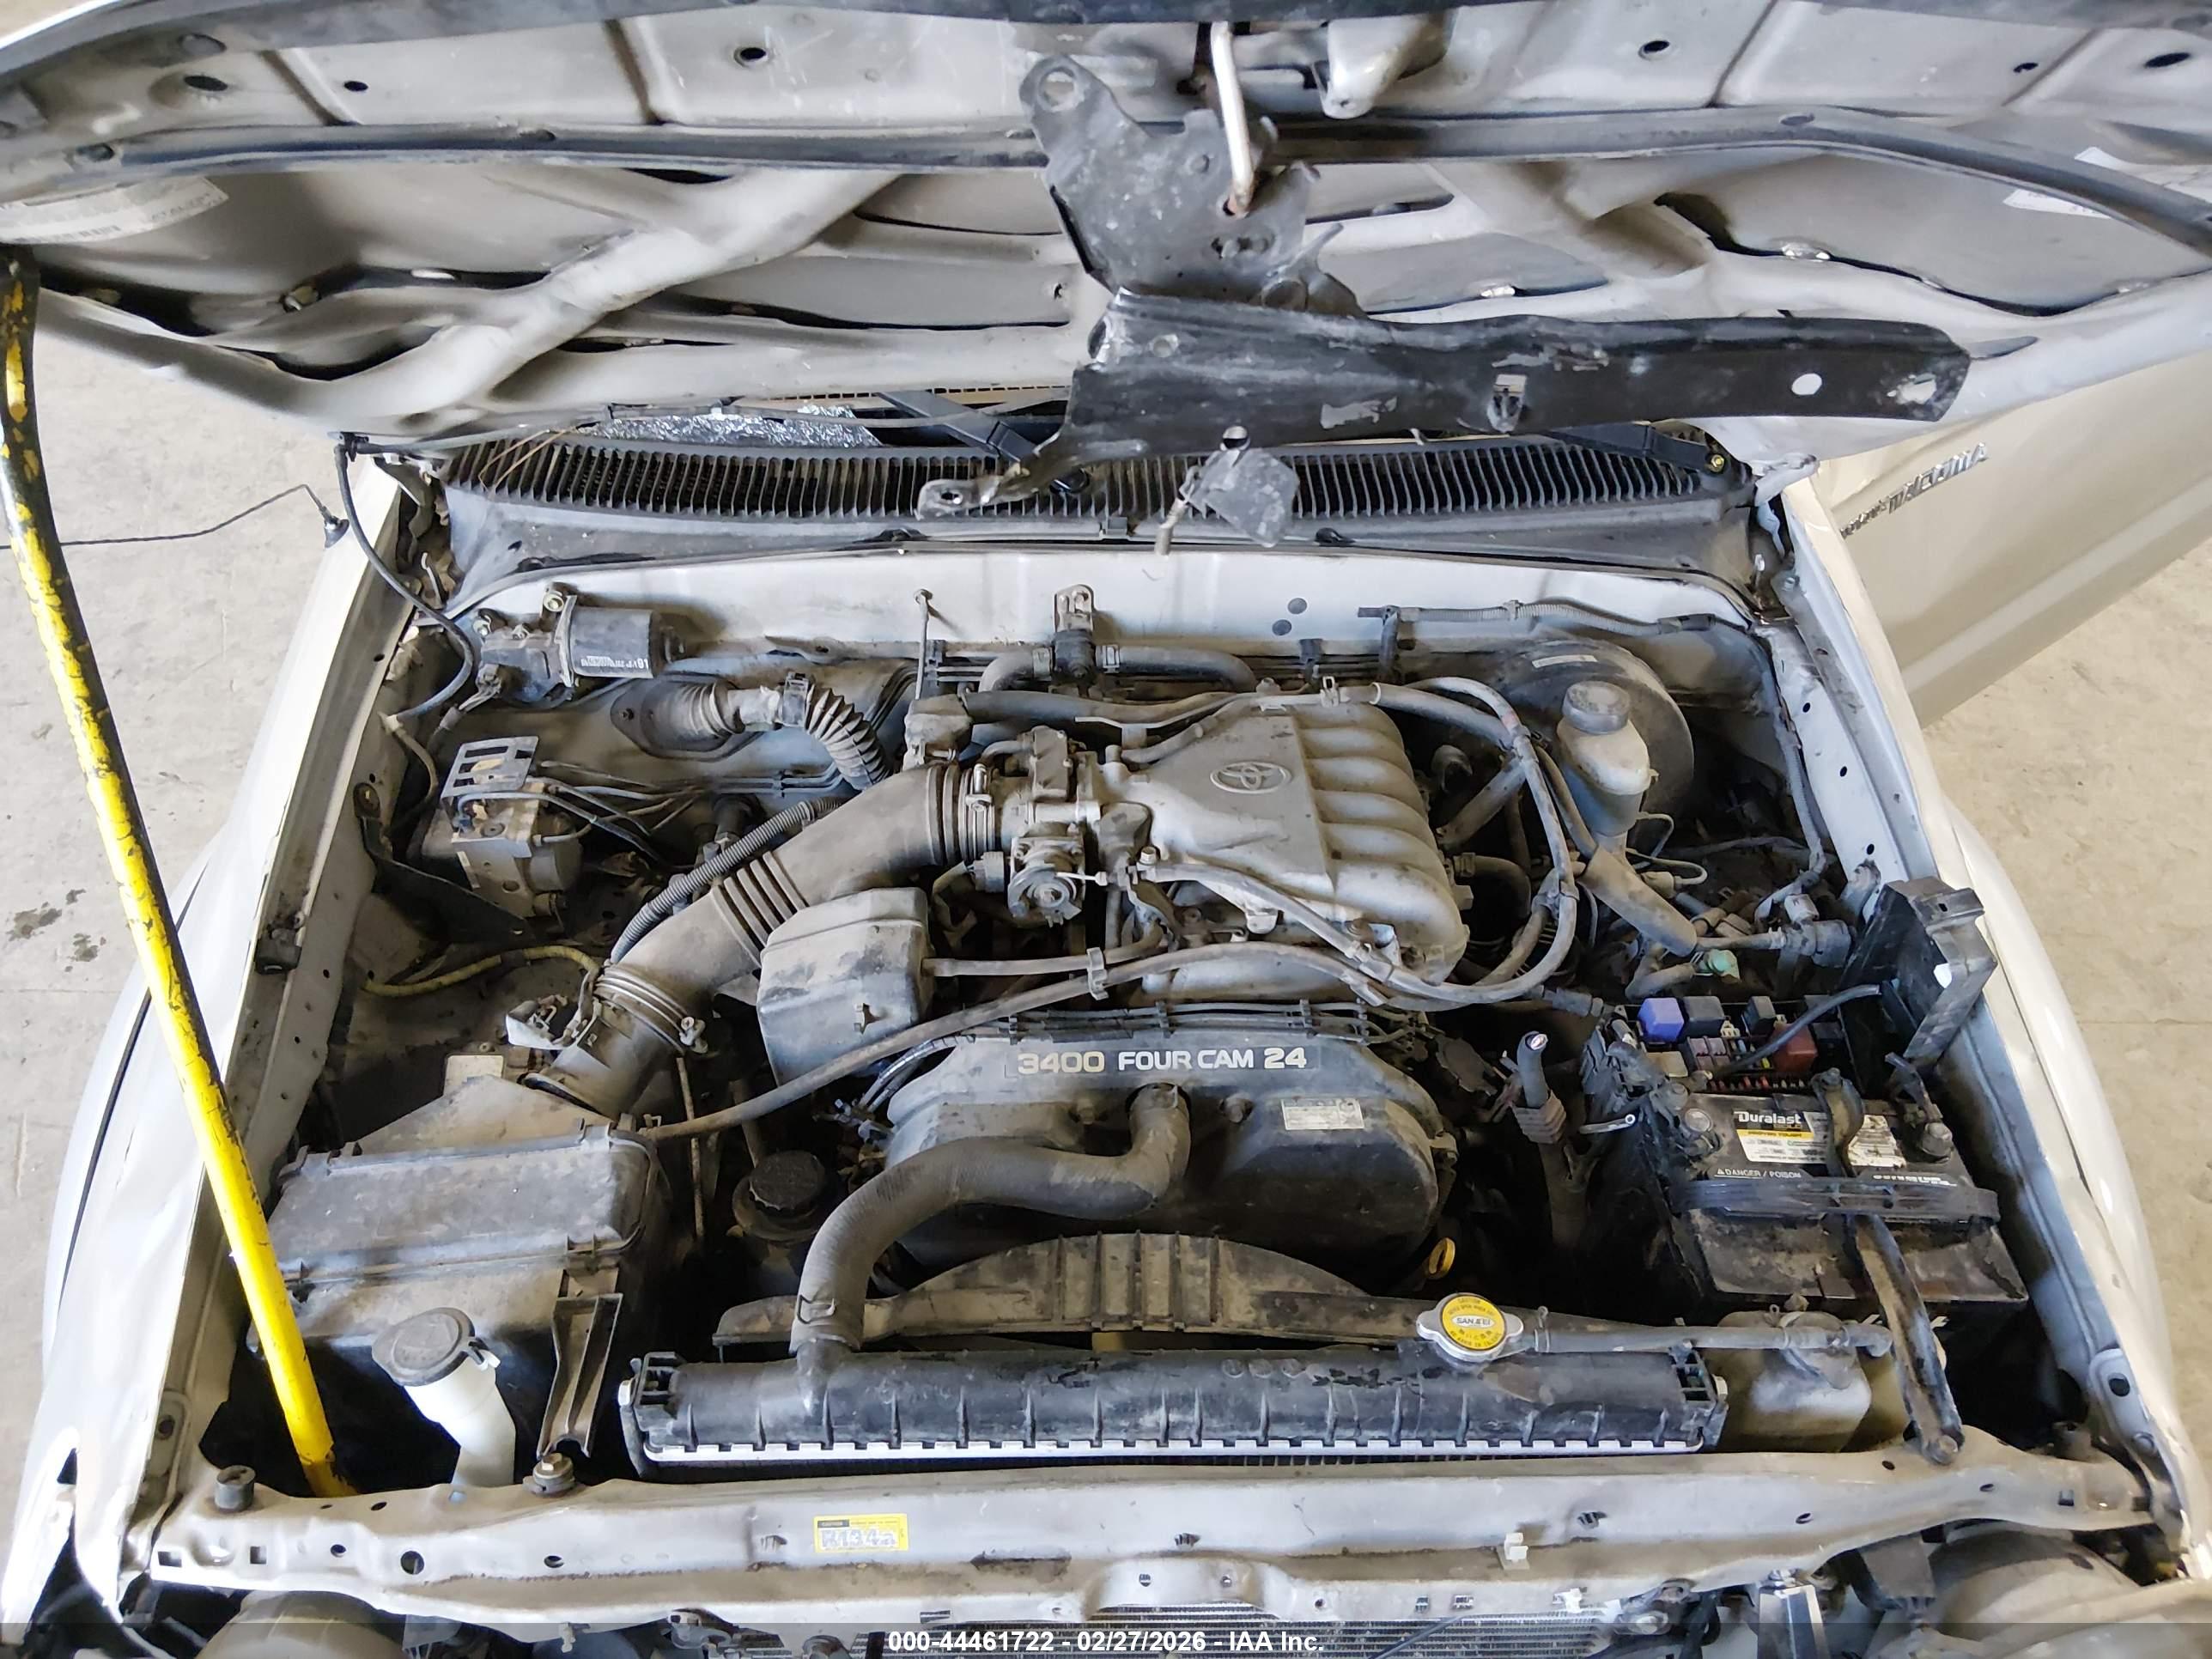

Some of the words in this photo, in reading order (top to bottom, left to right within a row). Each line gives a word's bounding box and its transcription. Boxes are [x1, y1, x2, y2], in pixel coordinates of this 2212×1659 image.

[1017, 1051, 1105, 1074] 3400
[1118, 1050, 1193, 1071] FOUR
[1197, 1049, 1254, 1069] CAM
[1263, 1047, 1307, 1069] 24
[1734, 1111, 1802, 1125] Duralast
[1725, 1169, 1761, 1177] DANGER
[822, 1528, 897, 1547] R134a
